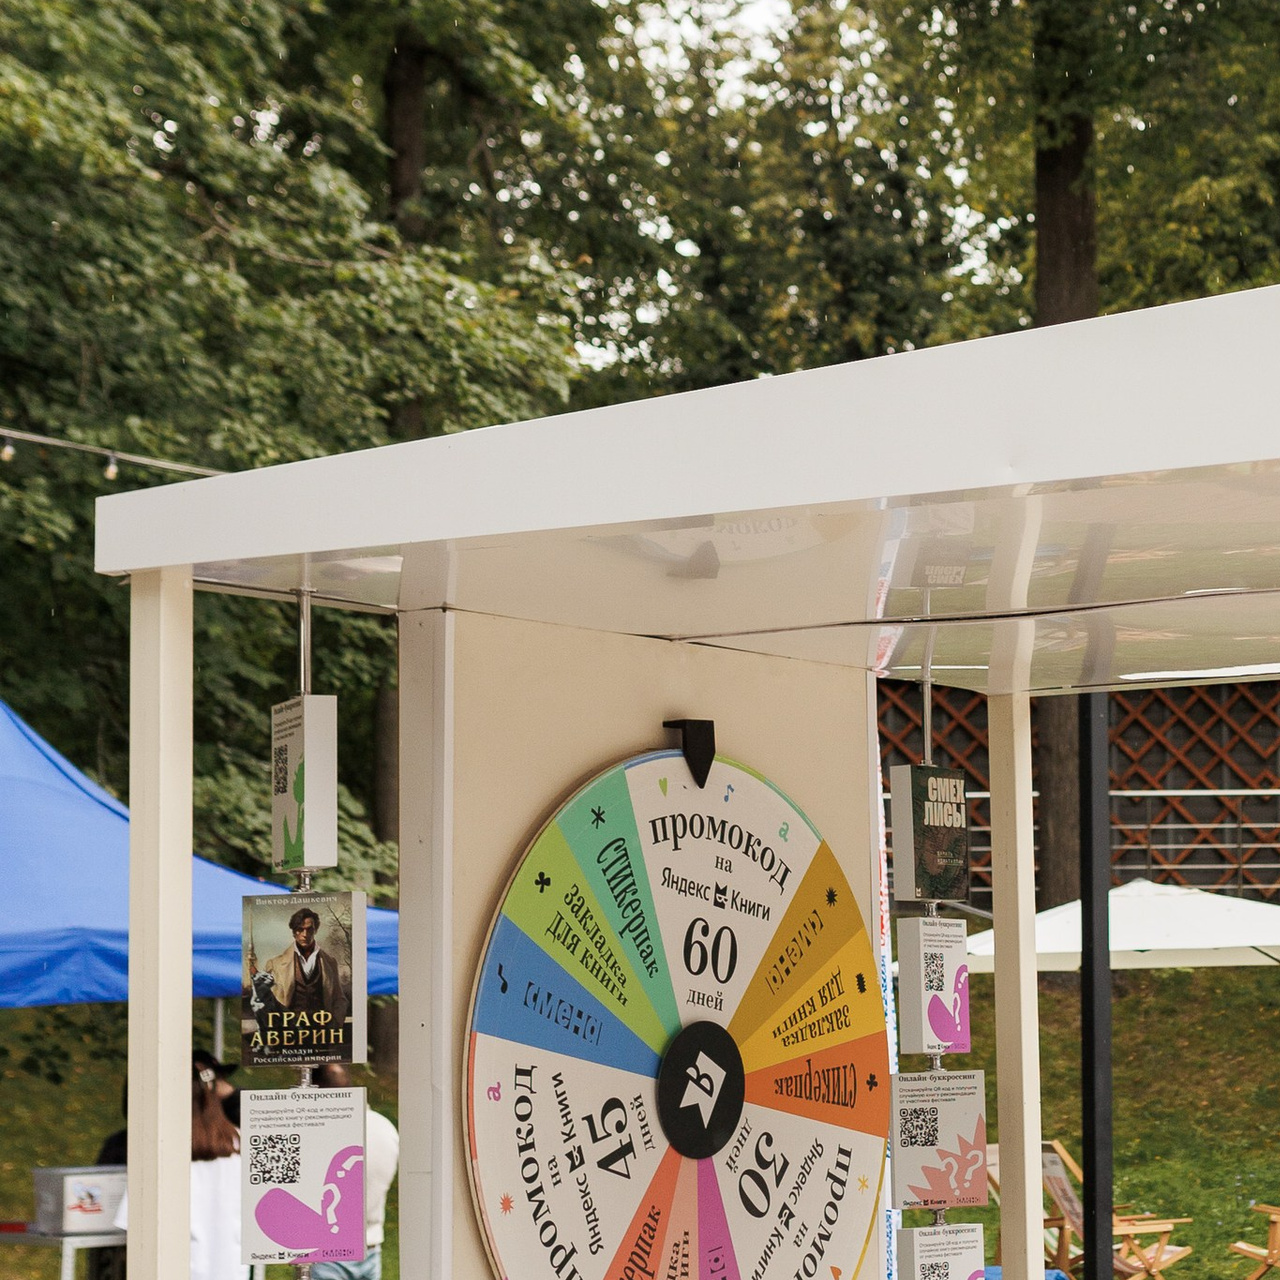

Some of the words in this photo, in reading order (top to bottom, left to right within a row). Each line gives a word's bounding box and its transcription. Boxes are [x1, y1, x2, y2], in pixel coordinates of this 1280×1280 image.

[928, 776, 965, 803] СМЕХ
[924, 801, 967, 828] ЛИСЫ
[649, 813, 792, 896] промокод
[714, 855, 733, 874] на
[255, 896, 289, 906] Виктор
[290, 895, 338, 905] Дашкевич
[596, 836, 660, 979] стикерпак
[661, 866, 711, 901] Яндекс
[730, 889, 771, 921] Книги
[563, 883, 628, 989] закладка
[683, 917, 738, 984] 60
[545, 911, 581, 956] для
[579, 946, 629, 1008] книги
[686, 989, 724, 1011] дней
[820, 965, 845, 1008] для
[250, 1028, 344, 1047] АВЕРИН
[267, 1010, 333, 1028] ГРАФ
[772, 997, 817, 1039] книги
[781, 1004, 852, 1048] закладка
[253, 1055, 302, 1064] Российской
[304, 1054, 342, 1063] империи
[282, 1048, 313, 1057] Колдун
[774, 1058, 858, 1109] стикерпак
[551, 1071, 577, 1144] Книги
[630, 1093, 656, 1152] дней
[581, 1096, 640, 1180] 45
[725, 1117, 753, 1174] дней
[547, 1154, 563, 1189] на
[738, 1131, 790, 1219] 30
[788, 1137, 824, 1206] Яндекс
[576, 1173, 604, 1256] Яндекс
[793, 1221, 809, 1249] на
[251, 1252, 276, 1261] Яндекс
